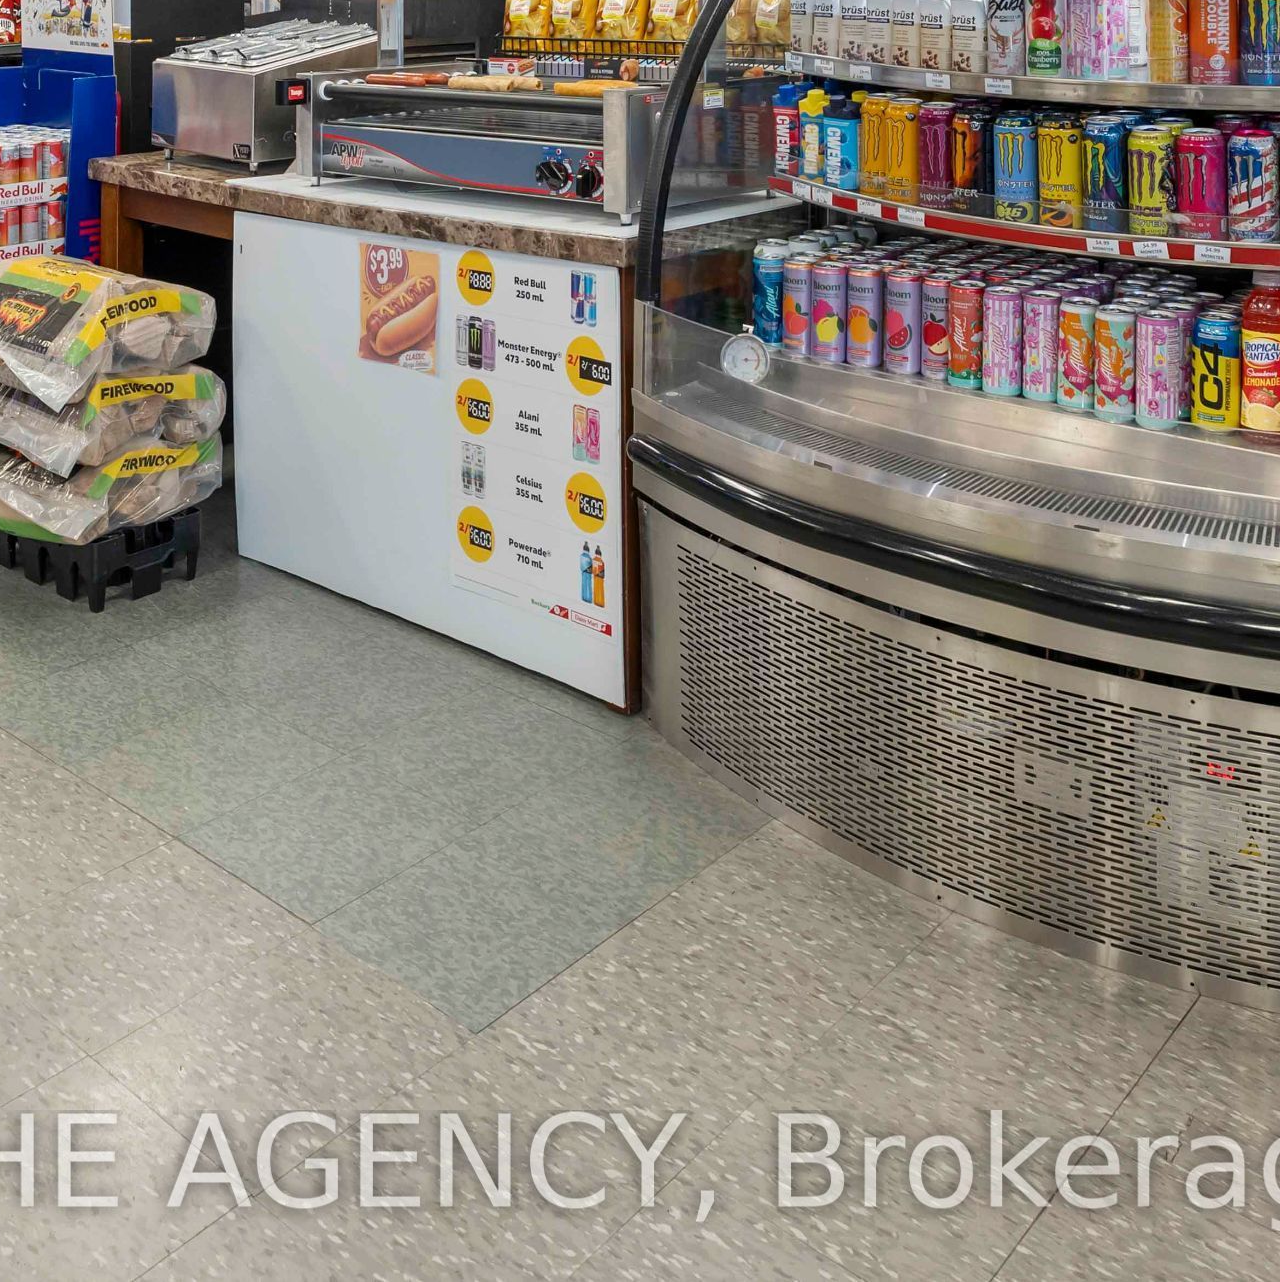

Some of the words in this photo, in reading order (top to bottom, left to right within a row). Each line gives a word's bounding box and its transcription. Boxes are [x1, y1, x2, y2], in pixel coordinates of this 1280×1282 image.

[841, 4, 867, 16] brüst
[866, 7, 891, 18] brüst
[893, 10, 915, 20] brüst
[920, 13, 943, 24] brüst
[951, 15, 976, 26] brüst
[1028, 55, 1059, 64] Cranberry
[331, 142, 358, 157] APW
[776, 115, 790, 170] CWENCH
[826, 126, 842, 185] CWENCH
[22, 182, 45, 197] Bull
[22, 244, 45, 258] Bull
[370, 247, 403, 285] $3.99
[514, 276, 530, 288] Red
[531, 279, 546, 290] Bull
[813, 281, 841, 292] Bloom
[515, 290, 531, 301] 250
[532, 293, 544, 302] mL
[497, 338, 529, 354] Monster
[1244, 341, 1280, 354] TROPICAL
[504, 353, 519, 364] 473
[526, 358, 541, 369] 500
[542, 362, 554, 372] mL
[1245, 351, 1280, 362] FANTASY
[1198, 342, 1224, 411] C4
[1244, 376, 1280, 387] LEMONADE
[100, 382, 175, 401] FIREWOOD
[1224, 376, 1232, 412] PERFORMANCE
[518, 409, 539, 423] Alani
[515, 421, 529, 433] 355
[529, 427, 542, 437] mL
[516, 474, 542, 490] Celsius
[515, 487, 529, 499] 355
[530, 493, 543, 503] mL
[516, 553, 530, 566] 710
[531, 559, 544, 570] mL
